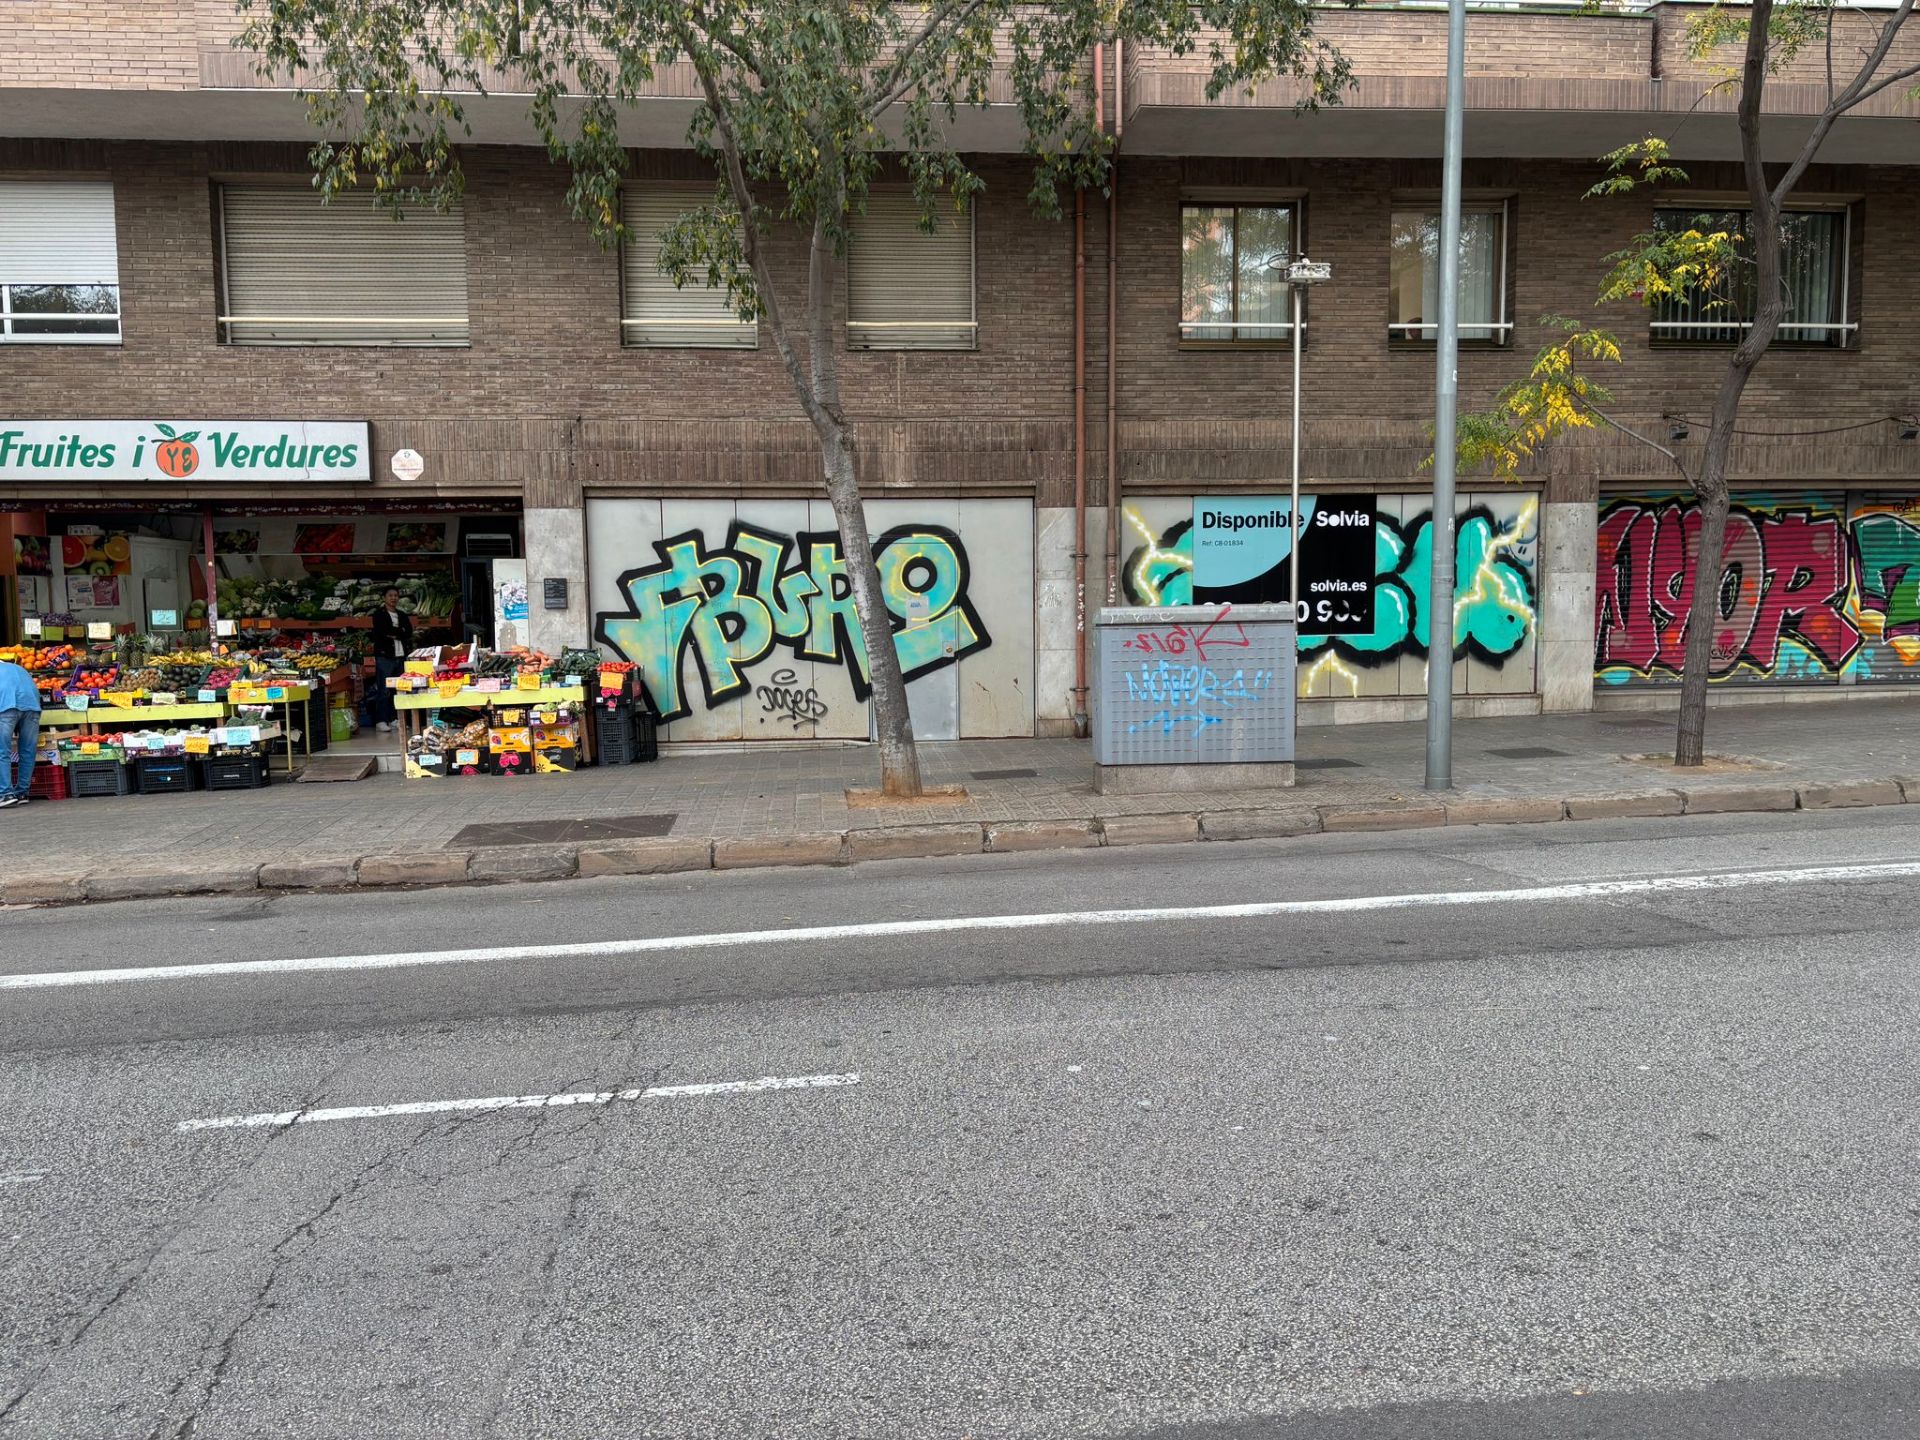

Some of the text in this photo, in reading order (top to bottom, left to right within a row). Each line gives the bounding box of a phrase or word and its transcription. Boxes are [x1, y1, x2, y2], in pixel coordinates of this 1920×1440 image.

[0, 431, 358, 468] Fruites i Verdures
[1202, 511, 1305, 532] Disponible
[1316, 510, 1370, 527] Solvia
[1310, 579, 1367, 592] solvia.es
